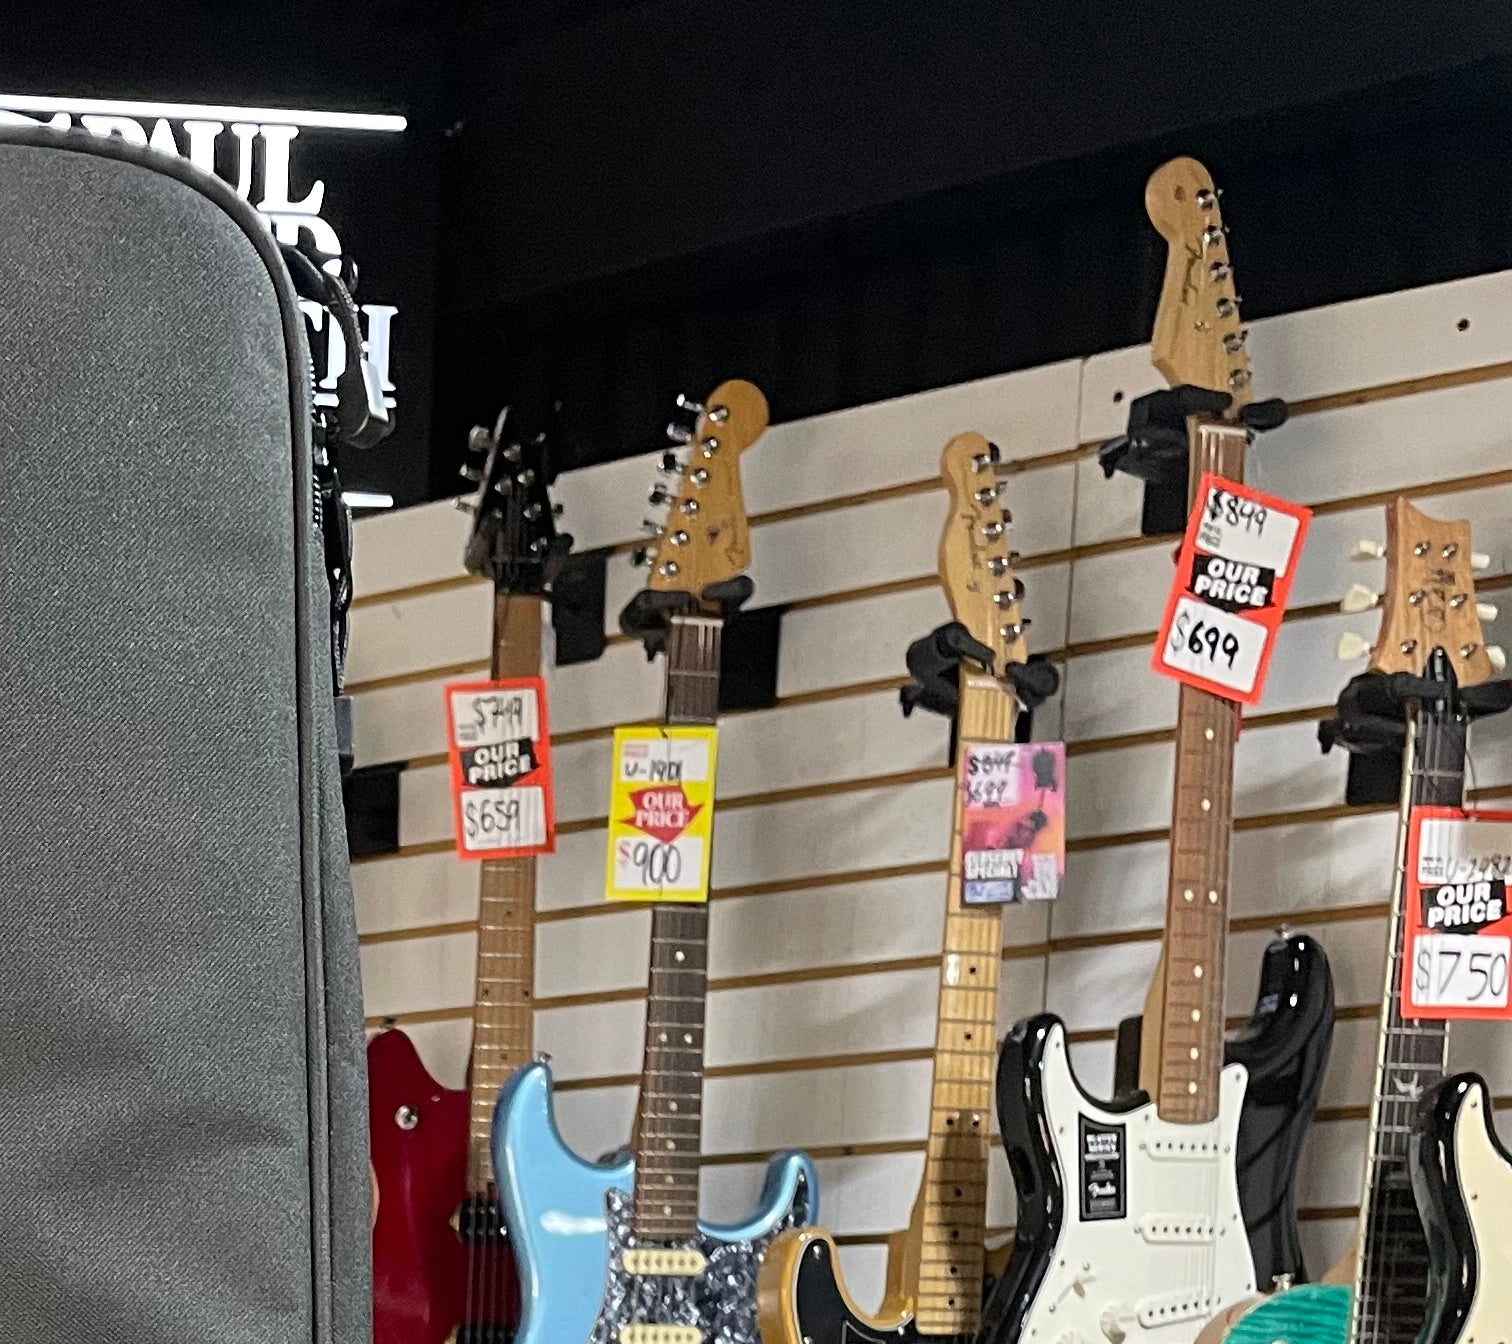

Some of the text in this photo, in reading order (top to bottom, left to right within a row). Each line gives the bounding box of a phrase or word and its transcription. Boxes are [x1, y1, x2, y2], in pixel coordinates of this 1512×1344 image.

[1207, 488, 1267, 538] $849
[1207, 558, 1261, 585] OUR
[1194, 574, 1269, 607] PRICE
[1171, 611, 1239, 670] $699
[474, 740, 520, 765] OUR
[468, 755, 532, 784] PRICE
[642, 791, 684, 810] OUR
[465, 799, 520, 837] $659
[636, 808, 690, 828] PRICE
[617, 842, 682, 885] $900
[1436, 882, 1492, 907] OUR
[1427, 899, 1503, 929] PRICE
[1416, 950, 1508, 1001] $750
